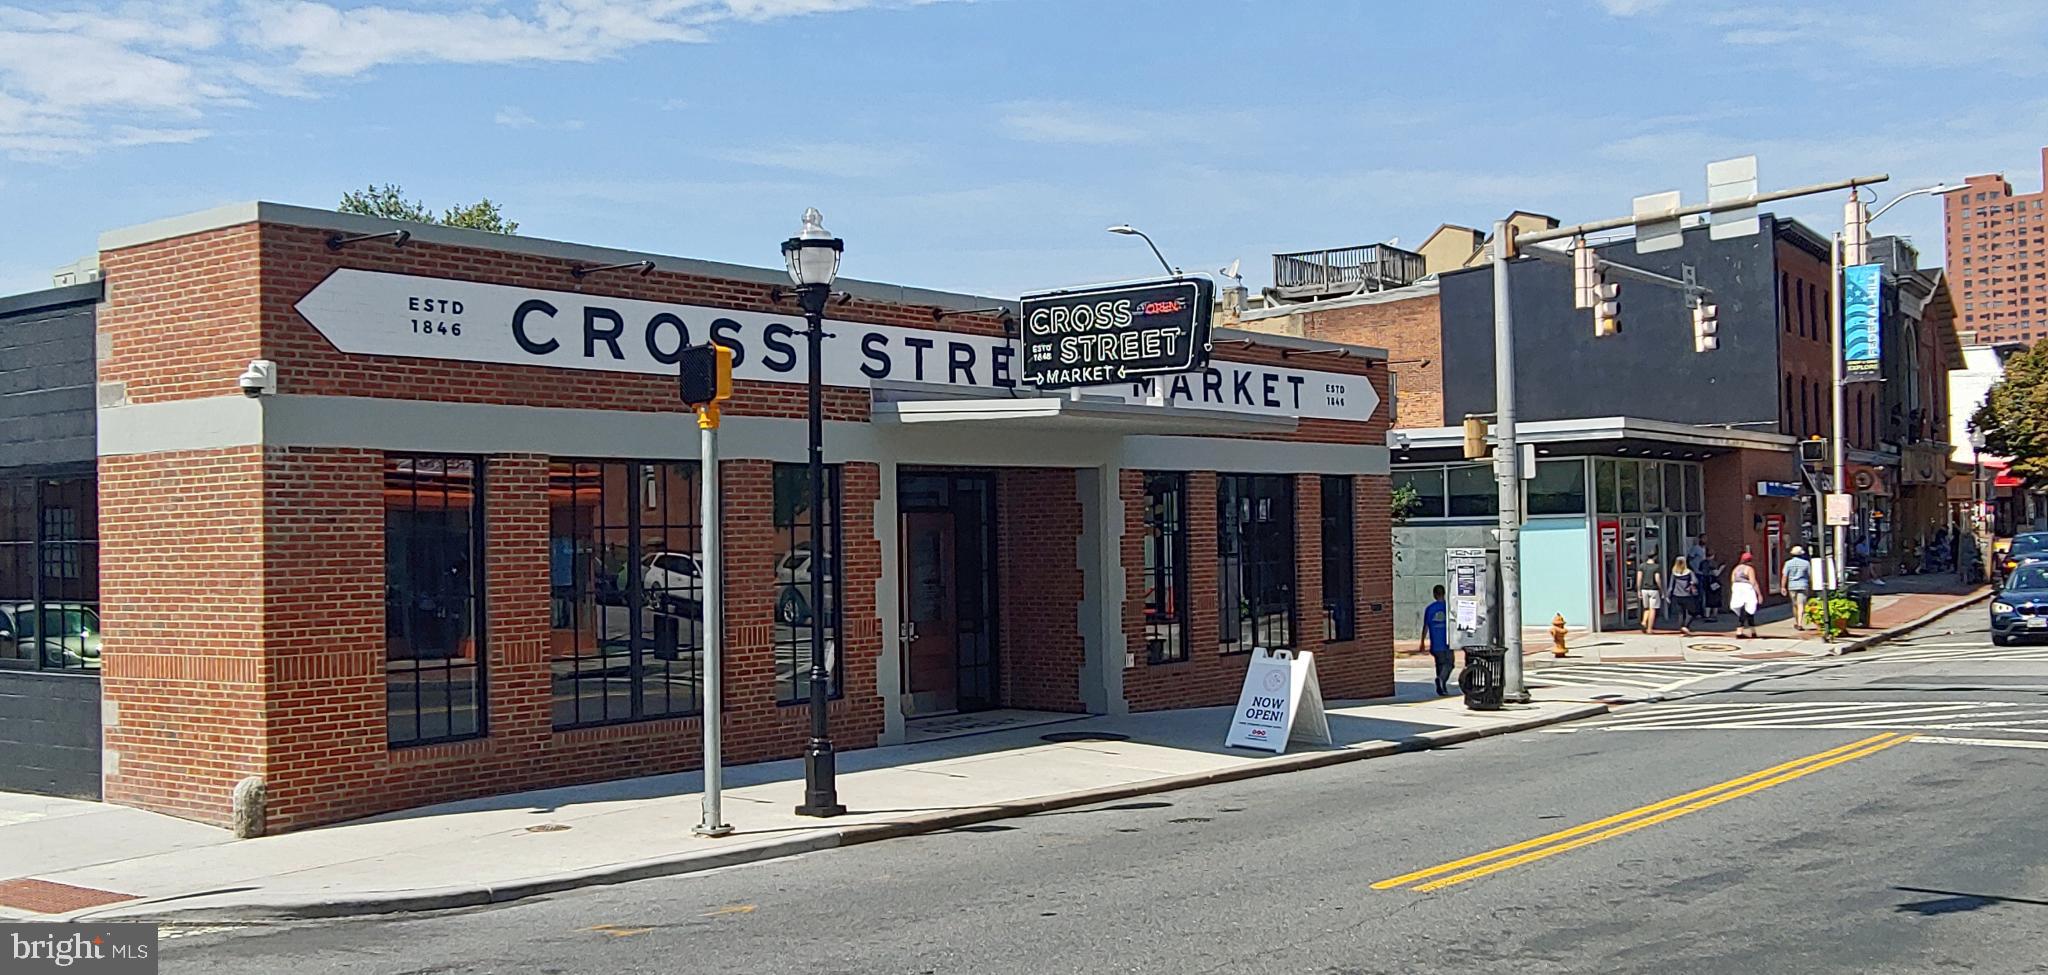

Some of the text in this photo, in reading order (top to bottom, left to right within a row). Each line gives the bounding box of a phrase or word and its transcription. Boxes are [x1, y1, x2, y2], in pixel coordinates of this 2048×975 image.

[409, 297, 464, 314] ESTD
[1867, 272, 1878, 356] FEDERAL HILL
[1029, 299, 1133, 335] CROSS
[411, 319, 461, 336] 1846
[512, 300, 797, 373] CROSS
[860, 332, 1017, 388] STRE
[1060, 327, 1181, 364] STREET
[1047, 366, 1114, 384] MARKET
[1252, 696, 1284, 709] NOW
[1246, 708, 1284, 722] OPEN!
